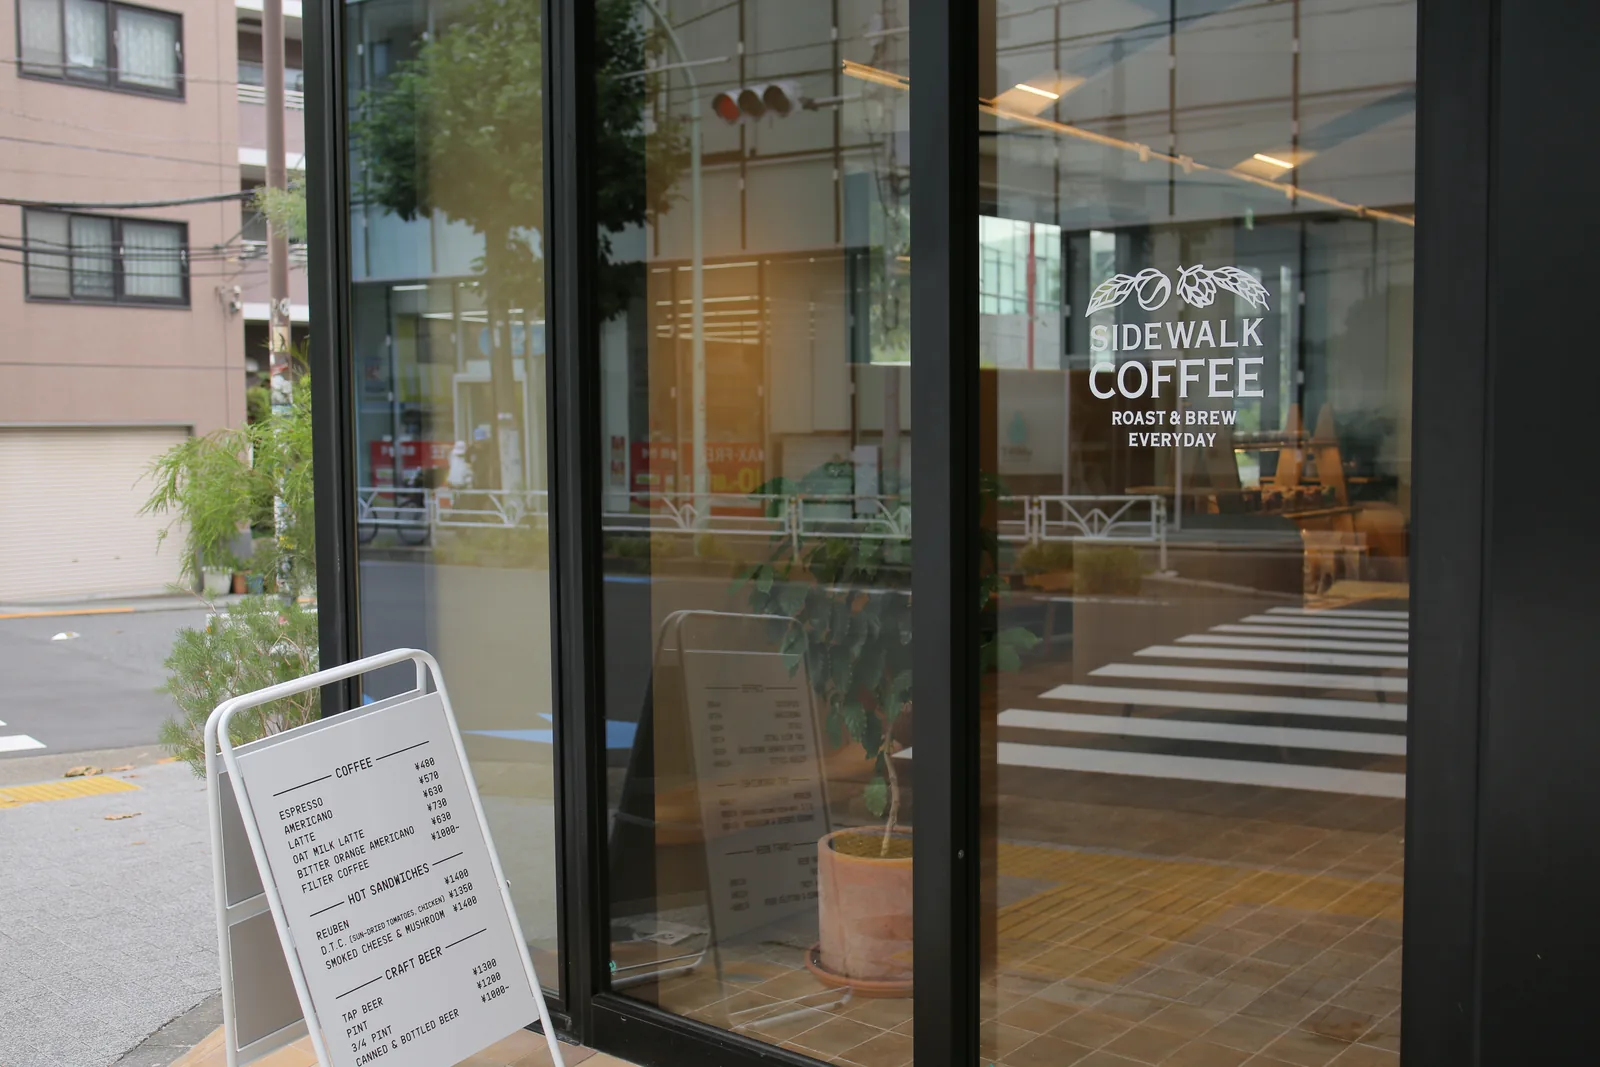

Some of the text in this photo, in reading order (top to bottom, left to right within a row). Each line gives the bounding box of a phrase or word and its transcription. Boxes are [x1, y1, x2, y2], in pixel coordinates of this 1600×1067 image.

[1090, 317, 1264, 352] SIDEWALK
[1089, 356, 1264, 400] COFFEE
[1111, 410, 1237, 426] ROAST & BREW
[1128, 432, 1217, 447] EVERYDAY
[335, 757, 373, 778] COFFEE
[414, 757, 435, 771] ¥480
[418, 771, 439, 784] ¥570
[422, 784, 443, 798] ¥630
[279, 797, 324, 821] ESPRESSO
[426, 798, 448, 812] ¥730
[284, 810, 333, 835] AMERICANO
[430, 811, 452, 825] ¥630
[288, 832, 316, 850] LATTE
[292, 829, 365, 864] OAT MILK LATTE
[297, 826, 415, 879] BITTER ORANGE AMERICANO
[301, 859, 370, 894] FILTER COFFEE
[347, 863, 430, 905] HOT SANDWICHES
[444, 868, 469, 885] ¥1400
[448, 882, 474, 899] ¥1350
[452, 895, 478, 912] ¥1400
[316, 920, 350, 940] REUBEN
[320, 938, 347, 956] D.T.C.
[325, 910, 446, 970] SMOKED CHEESE & MUSHROOM
[385, 946, 443, 980] CRAFT BEER
[472, 958, 497, 976] ¥1300
[476, 972, 501, 990] ¥1200
[342, 997, 384, 1023] TAP BEER
[346, 1020, 368, 1038] PINT
[355, 1008, 460, 1067] CANNED & BOTTLED BEER
[351, 1025, 393, 1053] 3/4 PINT
